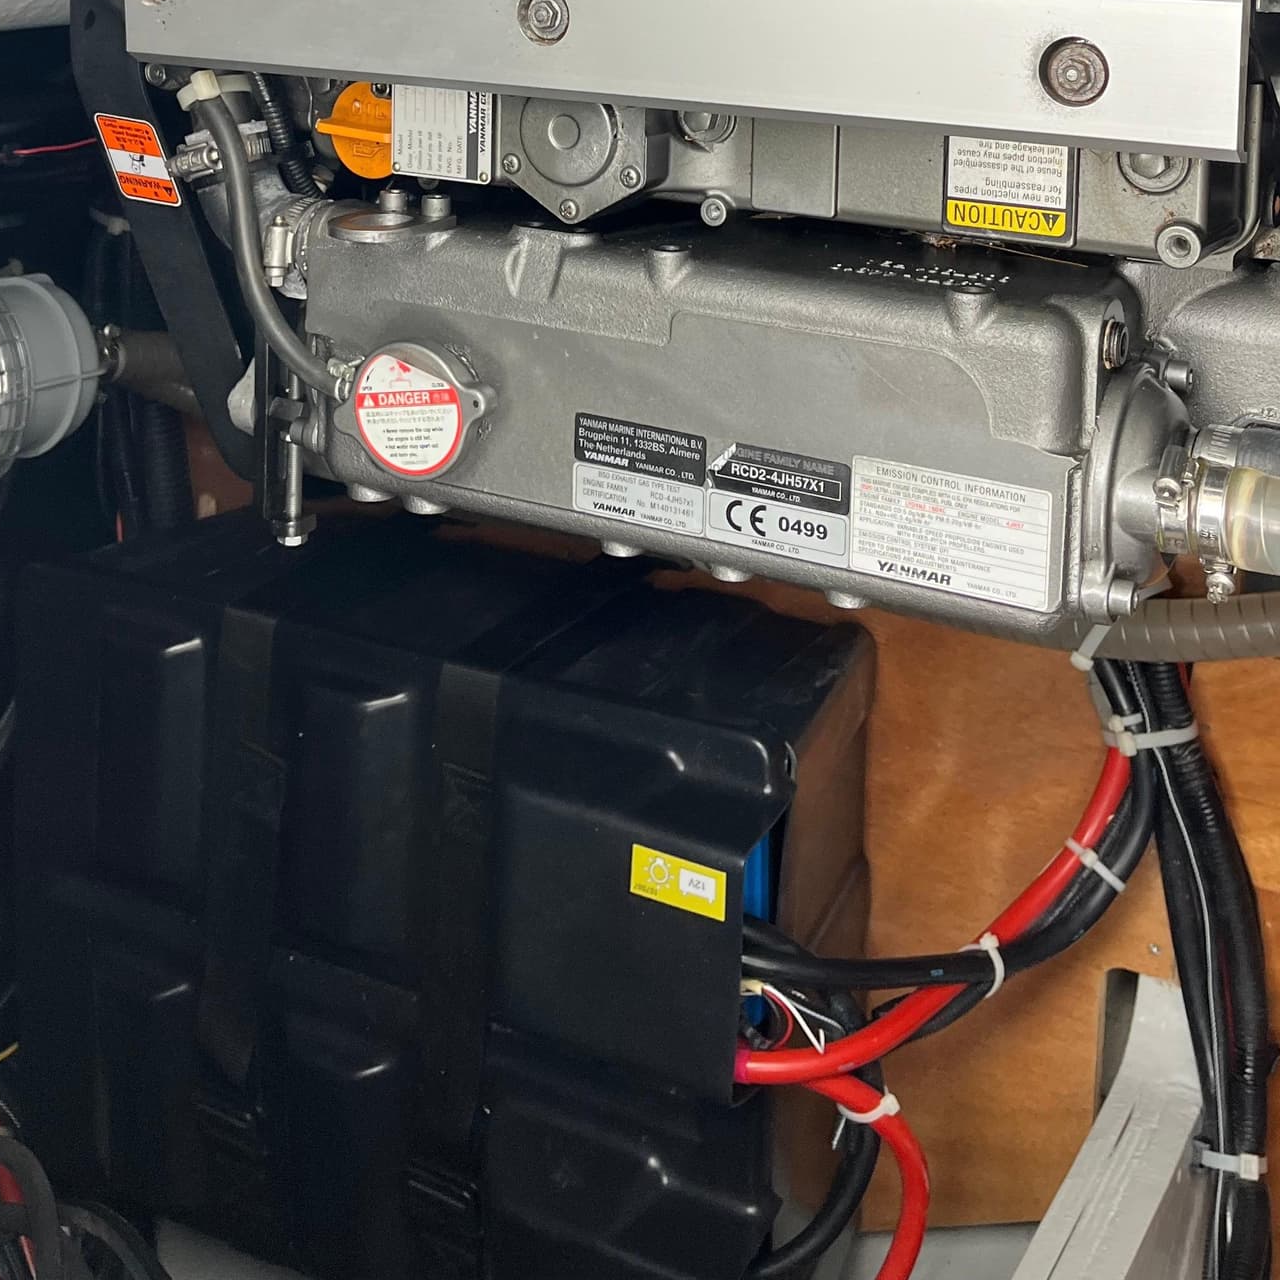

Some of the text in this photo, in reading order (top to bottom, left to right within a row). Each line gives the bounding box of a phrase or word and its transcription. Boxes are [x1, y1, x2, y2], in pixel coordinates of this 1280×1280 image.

[469, 91, 477, 135] YANMA
[995, 142, 1013, 151] and
[1013, 143, 1045, 154] leakage
[1048, 147, 1063, 156] fuel
[953, 158, 1009, 169] disassembled
[957, 148, 1063, 166] injection pipes may cause
[1010, 164, 1024, 173] the
[1037, 168, 1062, 178] Reuse
[119, 176, 161, 190] WARNING
[954, 185, 1061, 206] Use new injection pipes
[954, 203, 1041, 231] CAUTION
[378, 391, 431, 406] DANGER
[579, 416, 608, 431] YANMAR
[608, 421, 635, 437] MARINE
[635, 428, 689, 448] INTERNATIONAL
[579, 427, 619, 444] Brugplein
[669, 446, 701, 460] Almere
[579, 438, 646, 460] The Netherlands
[583, 450, 629, 467] YANMAR
[634, 461, 664, 474] YANMAR
[763, 453, 801, 469] FAMILY
[802, 459, 835, 475] NAME
[582, 477, 606, 489] ENGINE
[606, 481, 628, 493] FAMILY
[612, 472, 638, 485] EXHAUST
[651, 480, 664, 491] TYPE
[666, 483, 681, 493] TEST
[731, 462, 825, 493] RCD2-4JH57X1
[876, 466, 1026, 503] EMISSION CONTROL INFORMATION
[582, 488, 628, 504] CERTIFICATION
[751, 486, 776, 498] YANMAR
[592, 501, 663, 524] YANMAR YANMAR
[726, 500, 767, 537] CE
[778, 516, 828, 540] 0499
[751, 539, 775, 549] YANMAR
[877, 560, 990, 593] YANMAR YANMAR
[688, 877, 705, 891] 12V
